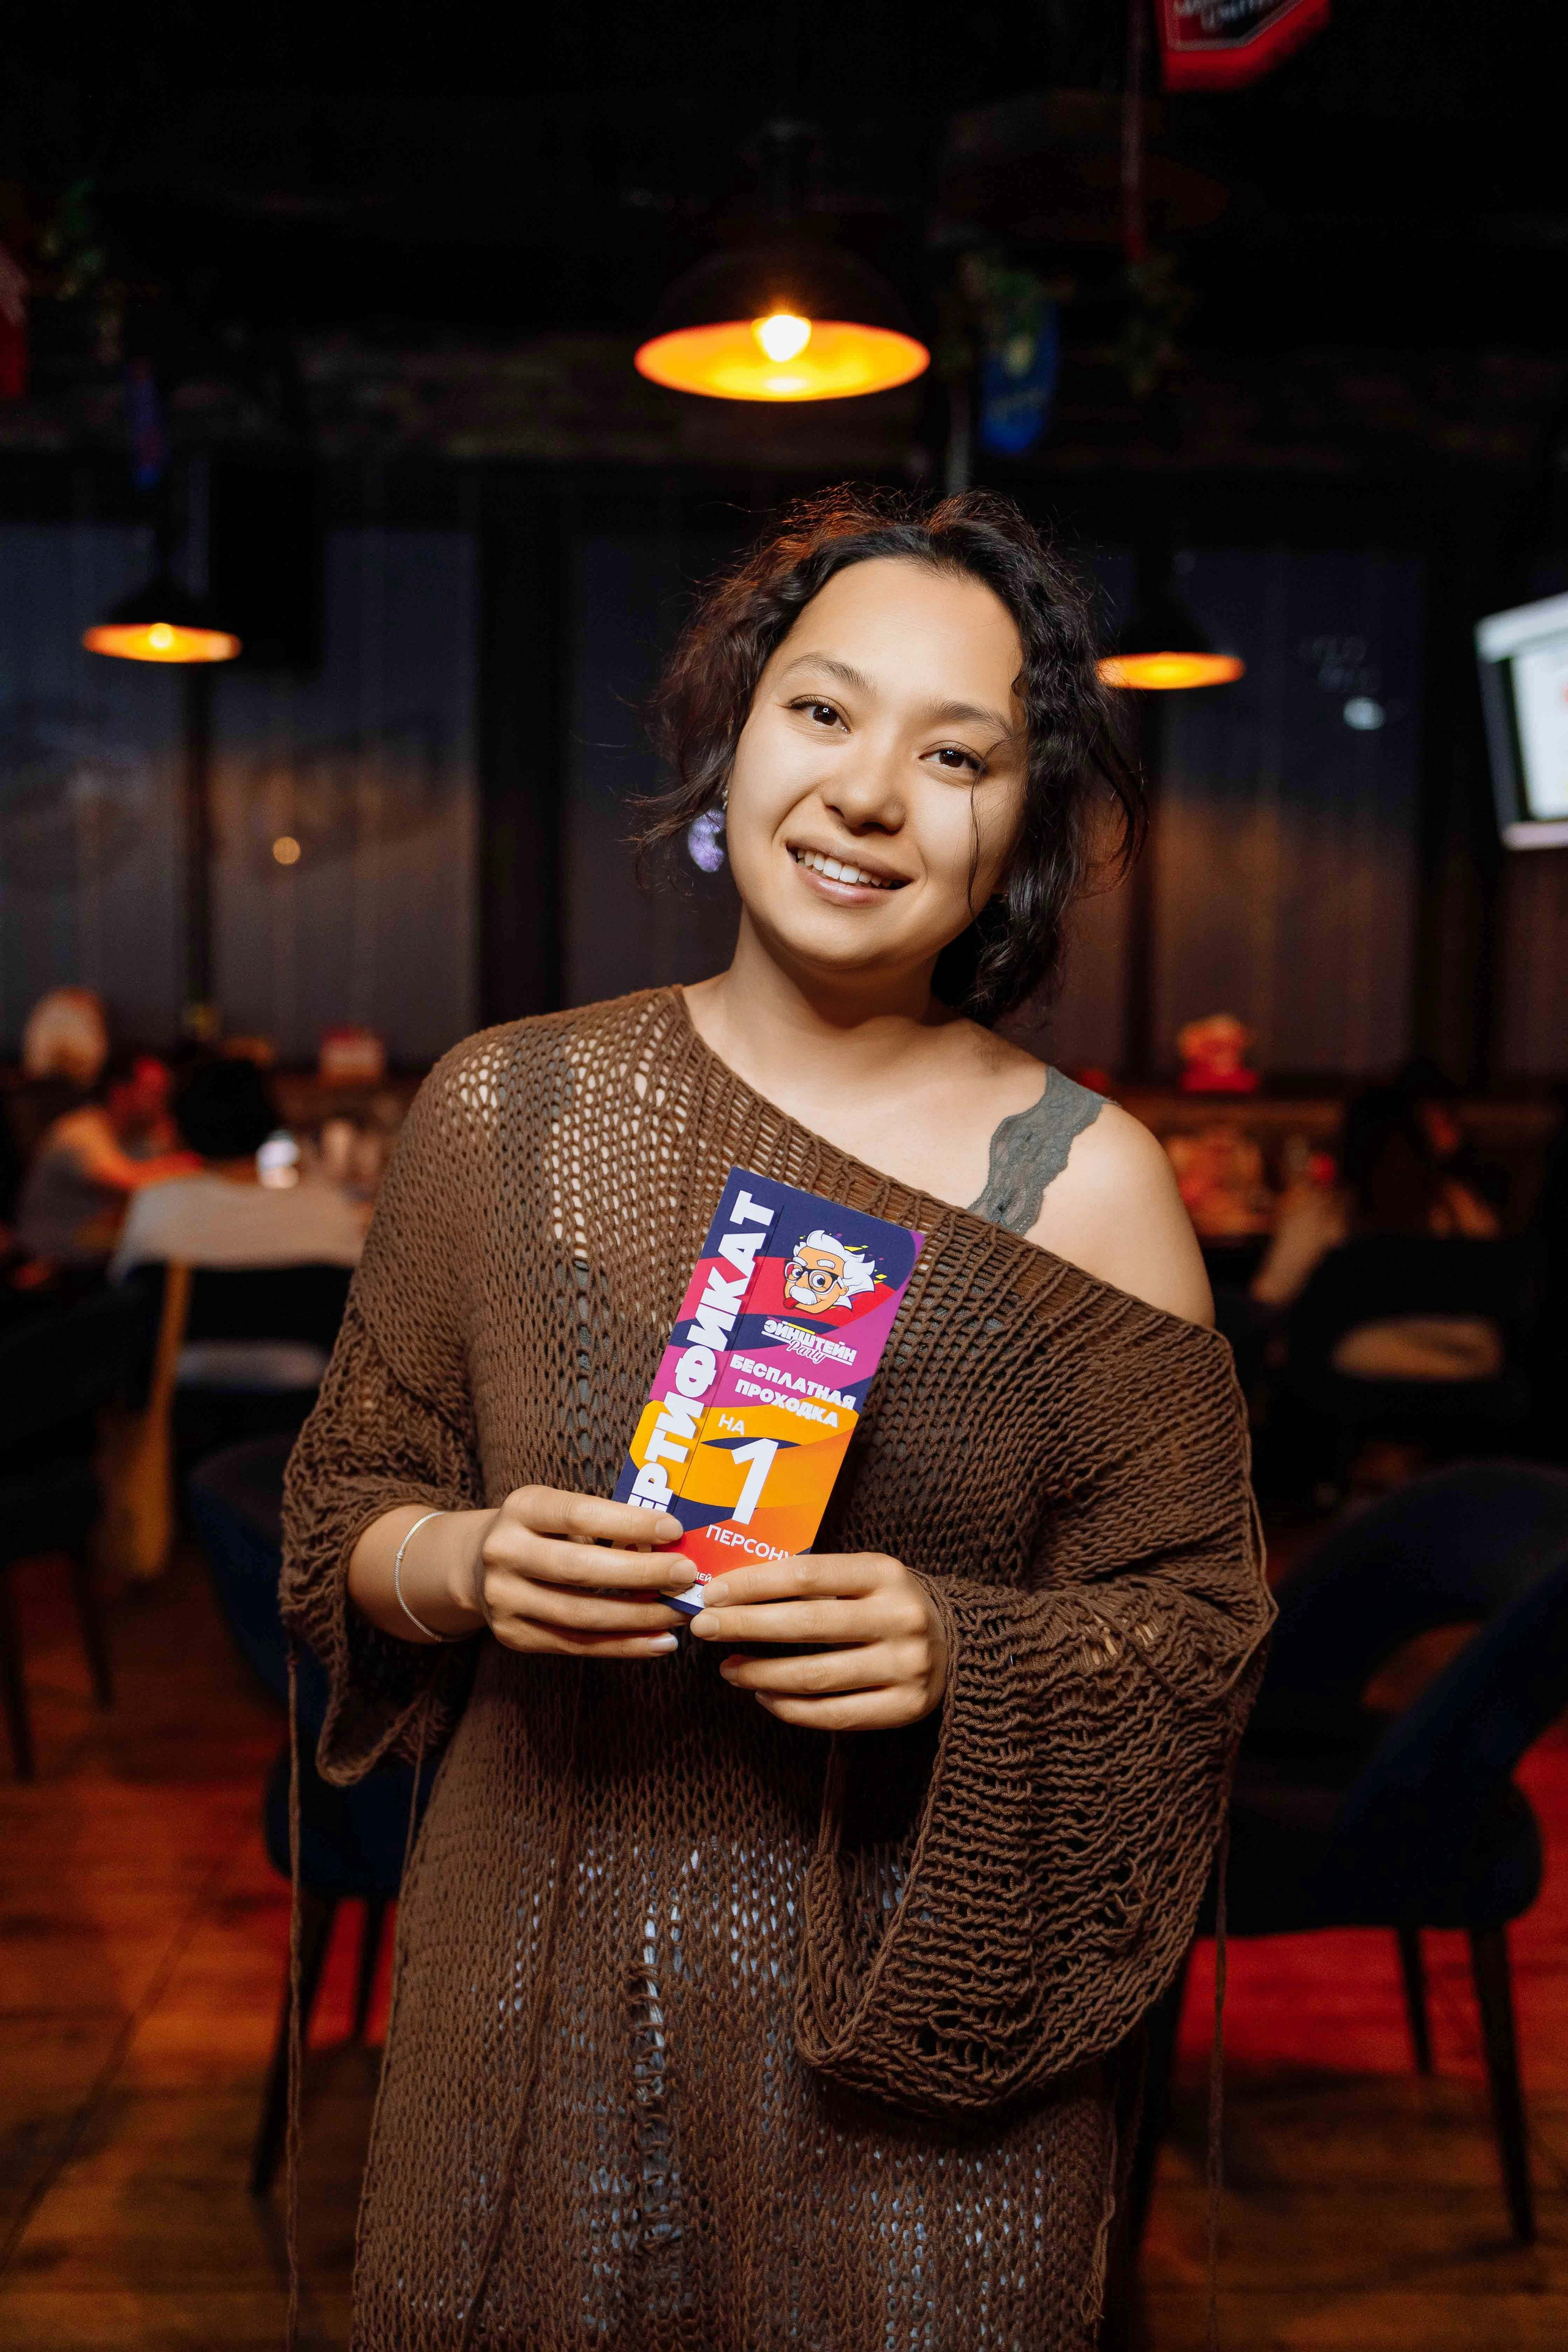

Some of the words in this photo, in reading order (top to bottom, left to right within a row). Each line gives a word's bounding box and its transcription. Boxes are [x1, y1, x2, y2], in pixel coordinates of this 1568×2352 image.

[627, 1189, 775, 1513] РТИФИКАТ
[764, 1320, 857, 1363] ЭЙНШТЕЙН
[786, 1340, 827, 1365] Party
[729, 1354, 856, 1410] БЕСПЛАТНАЯ
[735, 1379, 838, 1428] ПРОХОДКА
[718, 1414, 745, 1435] НА
[731, 1438, 778, 1525] 1
